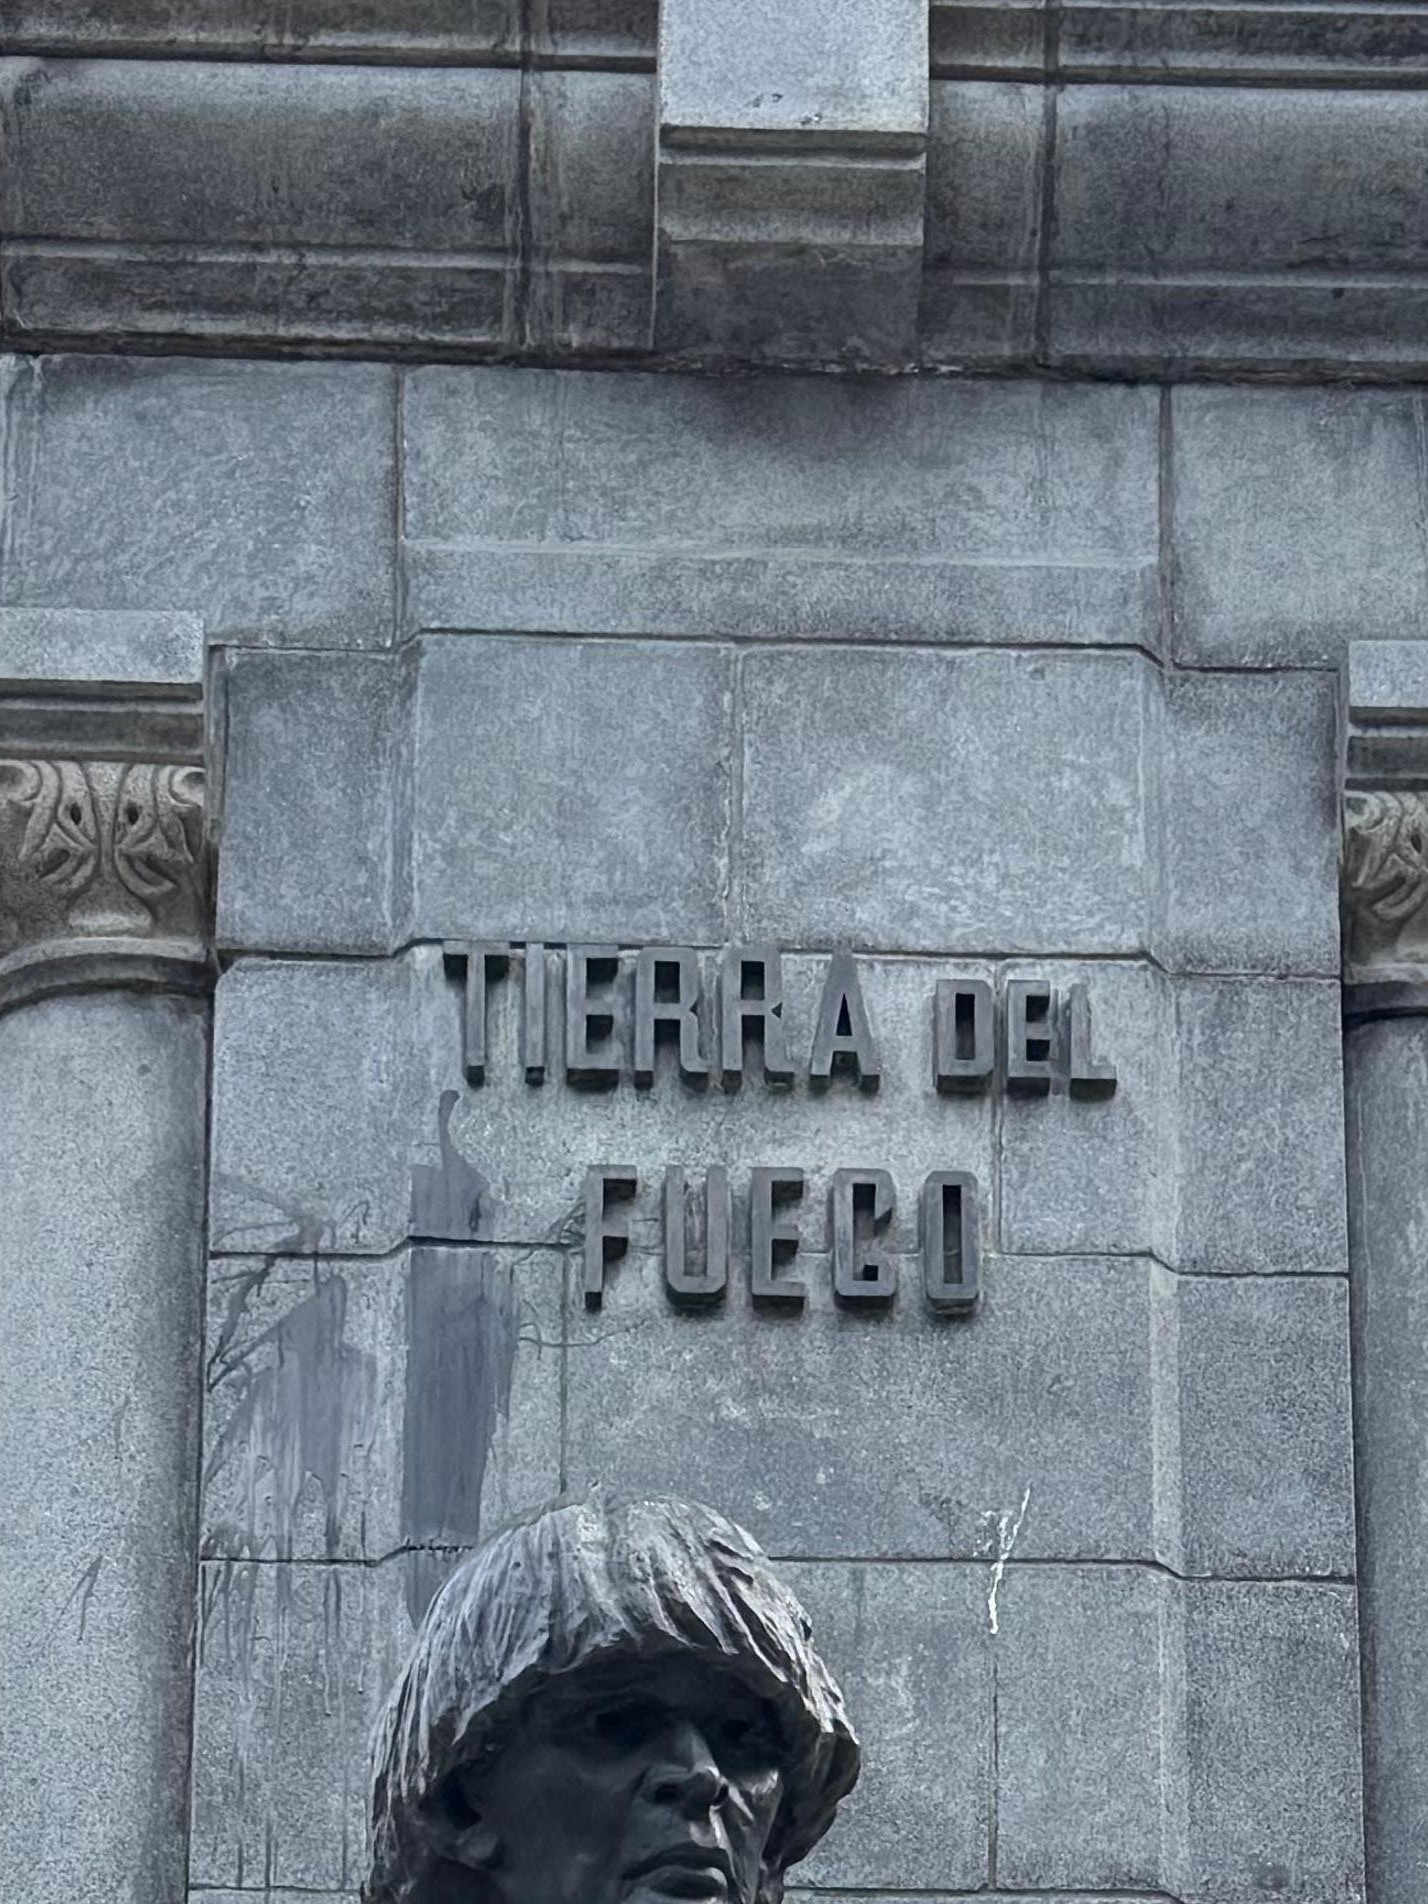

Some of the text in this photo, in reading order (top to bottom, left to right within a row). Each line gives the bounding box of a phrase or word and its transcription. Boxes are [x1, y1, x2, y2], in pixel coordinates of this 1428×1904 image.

[443, 941, 1117, 1096] TIERRA DEL
[583, 1164, 980, 1309] FUEGO
